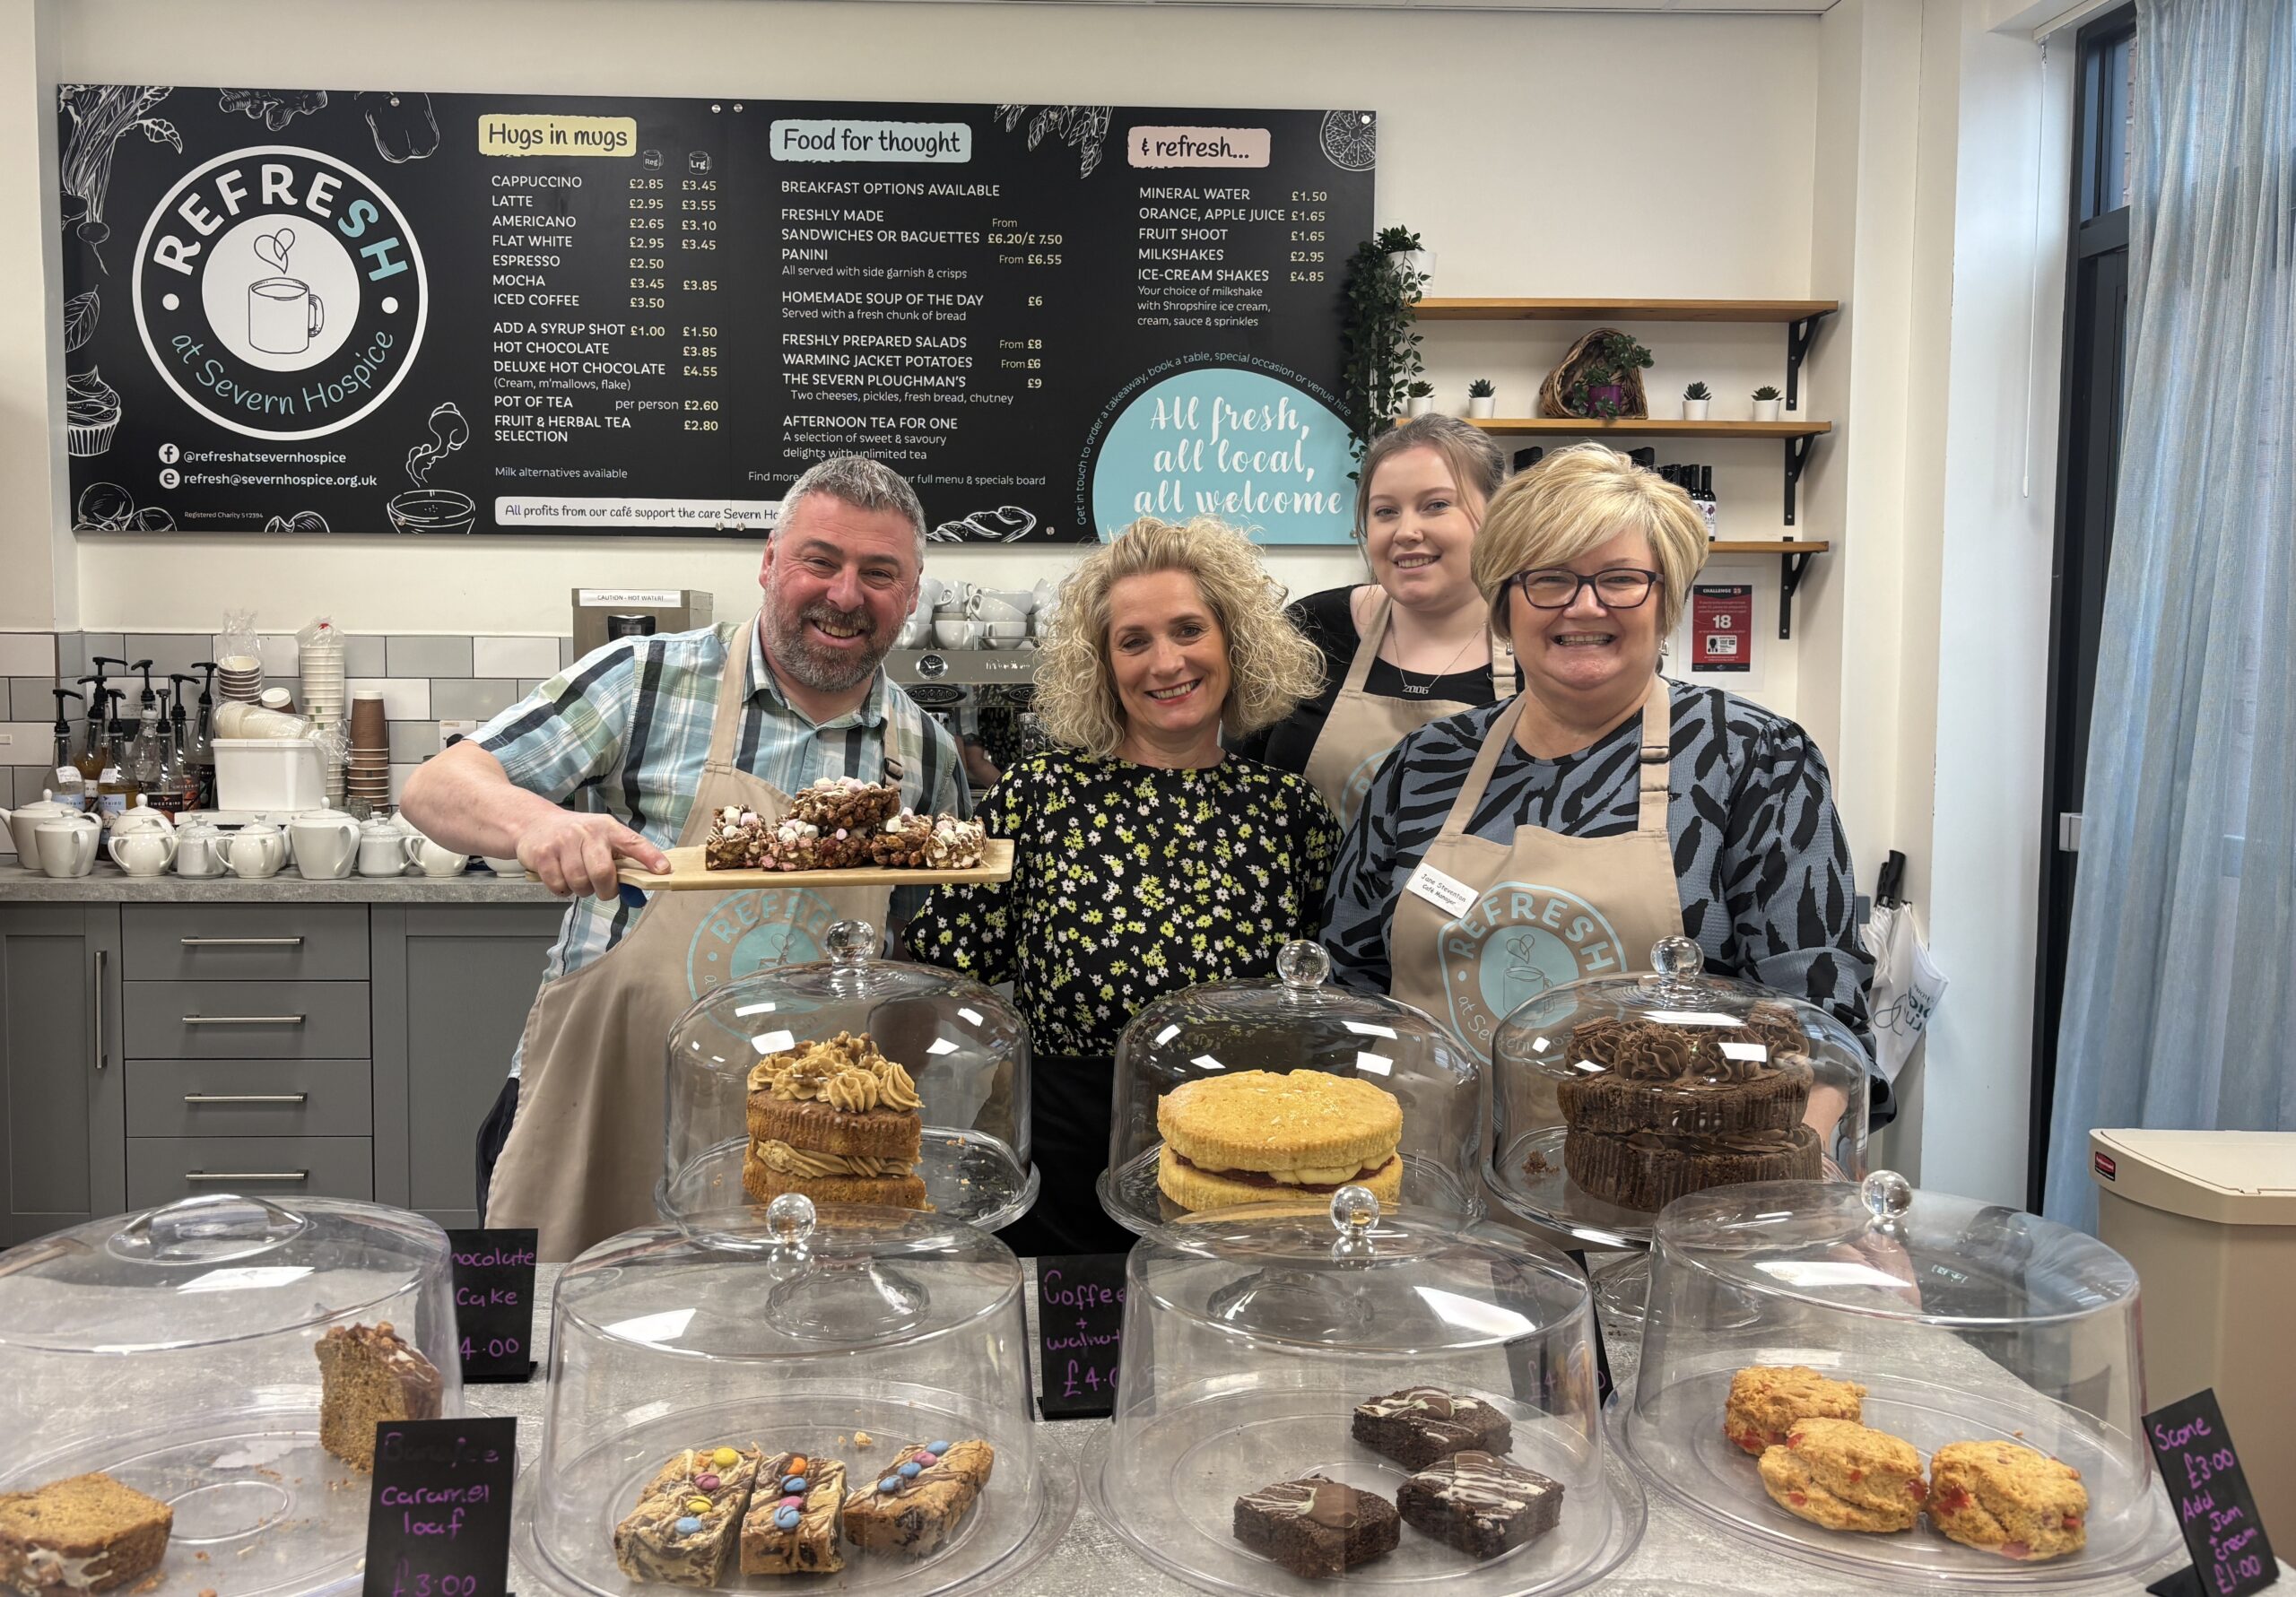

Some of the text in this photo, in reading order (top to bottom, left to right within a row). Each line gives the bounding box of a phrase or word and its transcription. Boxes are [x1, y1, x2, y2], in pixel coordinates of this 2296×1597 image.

[490, 123, 627, 152] Hugs in mugs
[785, 127, 961, 158] Food for thought
[1142, 138, 1149, 155] &
[645, 158, 706, 169] Reg Lrg
[492, 176, 716, 190] CAPPUCCINO £2.85 £3.45
[782, 181, 999, 195] BREAKFAST OPTIONS AVAILABLE
[1140, 187, 1326, 201] MINERAL WATER £1.50
[492, 195, 716, 210] LATTE £2.95 £3.55
[492, 215, 716, 230] AMERICANO £2.65 £3.10
[782, 209, 883, 221] FRESHLY MADE
[153, 164, 408, 282] REFRESH
[993, 219, 1017, 227] From
[493, 235, 716, 249] FLAT WHITE £2.95 £3.45
[782, 229, 873, 241] SANDWICHES
[877, 230, 897, 241] OR
[901, 231, 979, 243] BAGUETTES
[1140, 229, 1325, 241] FRUIT SHOOT £1.65
[782, 248, 1061, 265] PANINI From £6.55
[1139, 248, 1324, 262] MILKSHAKES £2.95
[782, 265, 967, 280] All served with side garnish & crisps
[1139, 269, 1324, 282] ICE-CREAM SHAKES £4.85
[493, 275, 717, 291] MOCHA £3.45 £3.85
[1138, 286, 1262, 296] Your choice of milkshake
[494, 294, 664, 308] ICED COFFEE £3.50
[783, 334, 1041, 349] FRESHLY PREPARED SALADS From £8
[172, 331, 393, 415] at Severn Hospice
[783, 373, 1041, 388] THE SEVERN PLOUGHMAN'S £9
[494, 377, 535, 389] (Cream,
[602, 379, 631, 391] flake)
[495, 395, 718, 411] POT OF TEA per person £2.60
[791, 390, 1013, 404] Two cheeses, pickles, fresh bread, chutney
[1150, 396, 1309, 446] All fresh,
[495, 430, 567, 442] SELECTION
[184, 451, 346, 464] @refreshatsevernhospice
[1153, 438, 1315, 482] all local,
[496, 467, 627, 478] Milk alternatives available
[185, 473, 377, 488] refresh@severnhospice.org.uk
[1134, 480, 1343, 515] all welcome
[506, 505, 521, 515] All
[524, 505, 559, 518] profits
[562, 505, 587, 516] from
[610, 506, 631, 516] café
[635, 508, 675, 520] support
[678, 508, 695, 517] the
[724, 508, 761, 519] Severn
[1713, 614, 1731, 629] 18
[1422, 873, 1435, 884] Jane
[1435, 891, 1456, 905] Manager
[710, 893, 830, 949] REFRE
[1448, 892, 1614, 971] REFRESH
[1458, 996, 1474, 1016] at
[451, 1247, 536, 1266] ocolate
[457, 1288, 517, 1306] Cake
[1044, 1270, 1126, 1310] Coffee
[2154, 1418, 2212, 1450] Scone
[2182, 1489, 2214, 1523] Add
[404, 1507, 465, 1540] loaf
